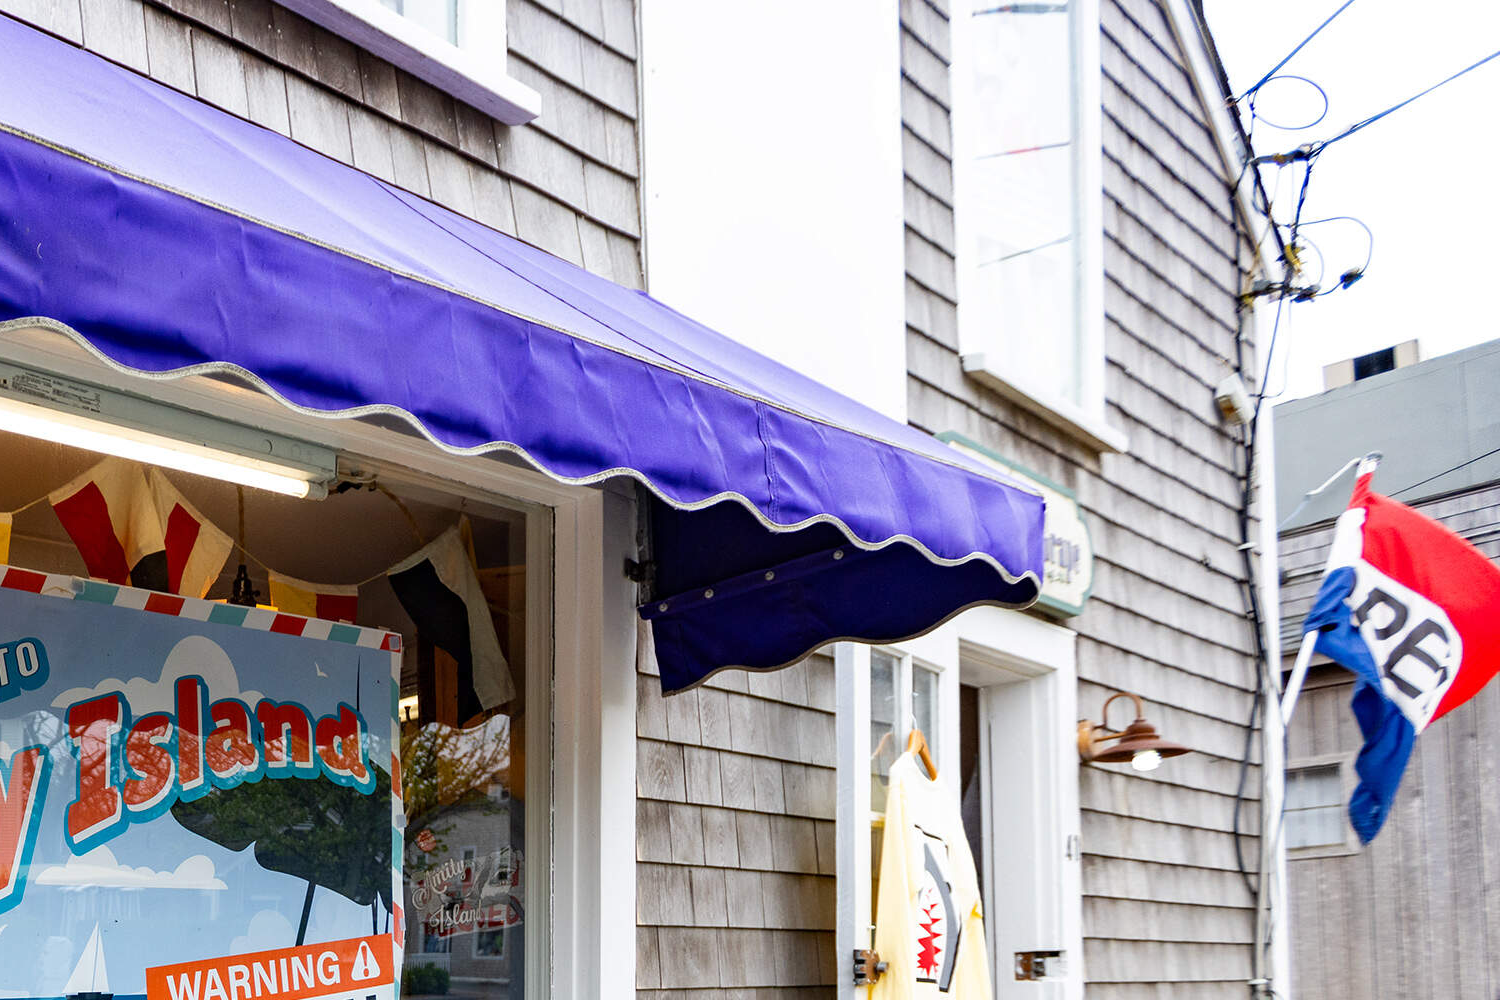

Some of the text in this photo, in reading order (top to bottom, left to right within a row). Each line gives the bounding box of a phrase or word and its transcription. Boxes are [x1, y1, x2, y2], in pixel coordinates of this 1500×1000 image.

[66, 677, 374, 853] Island
[412, 858, 466, 911] Amity
[429, 899, 482, 933] Island
